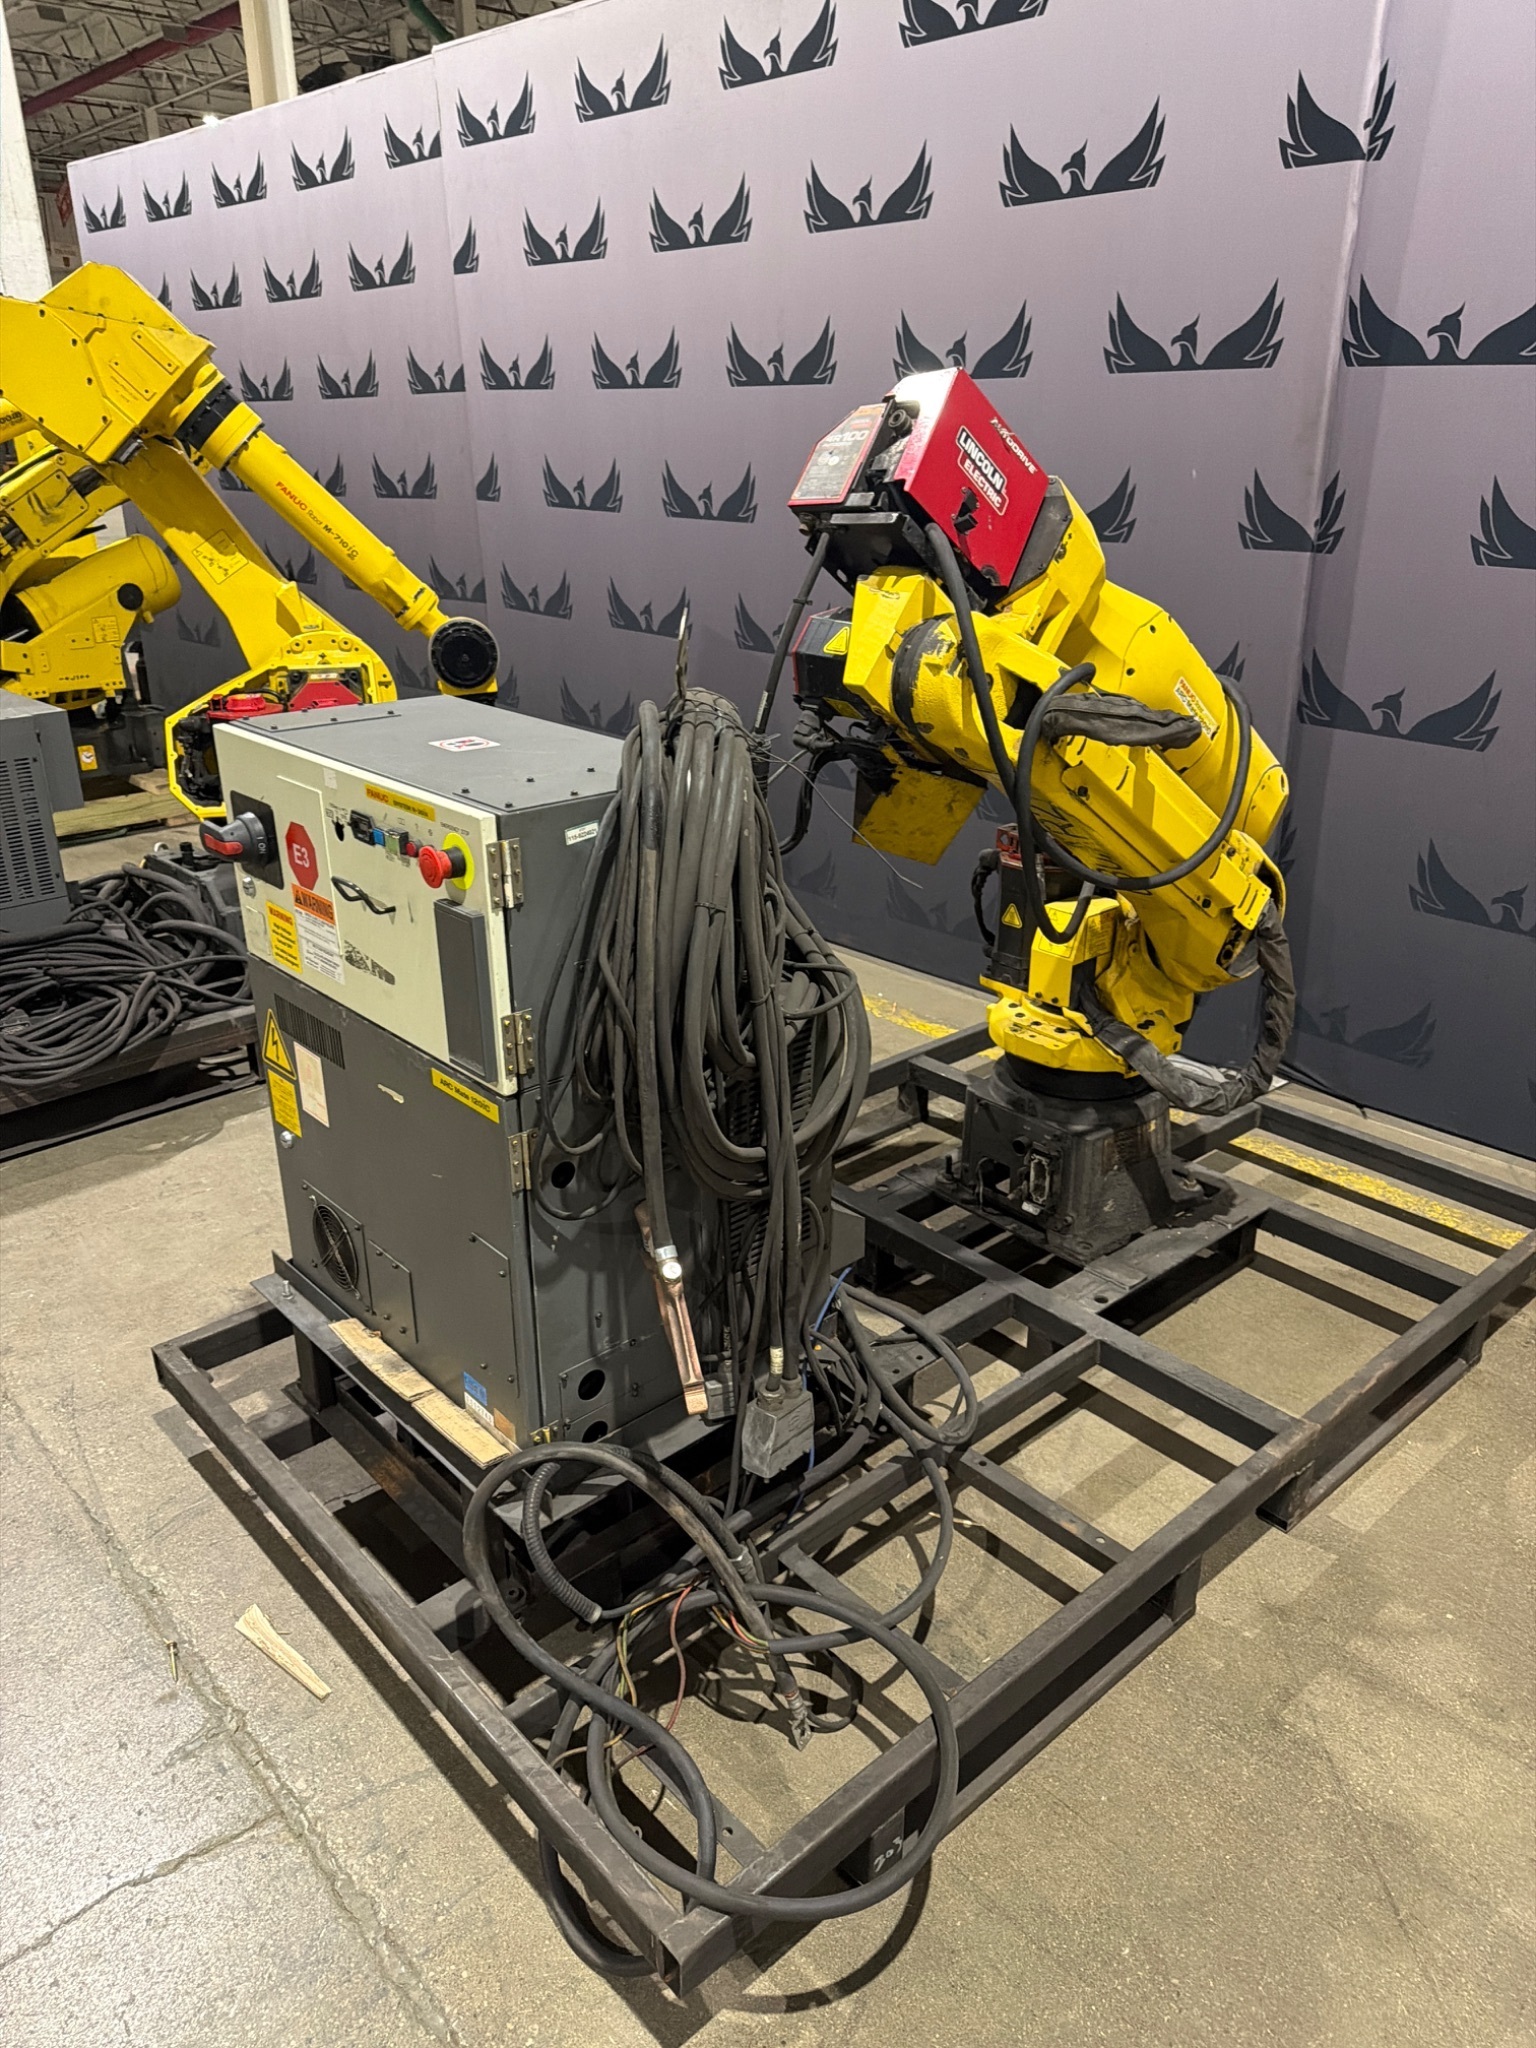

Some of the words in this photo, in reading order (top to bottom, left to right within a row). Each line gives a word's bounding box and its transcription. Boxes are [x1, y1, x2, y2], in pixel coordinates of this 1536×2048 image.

[959, 431, 1004, 491] LINCOLN
[275, 481, 308, 511] FANUC
[963, 458, 1003, 508] ELECTRIC
[366, 788, 389, 803] FANUC
[257, 842, 267, 854] ON
[292, 842, 310, 869] E3
[268, 905, 294, 927] WARNING
[300, 890, 335, 922] WARNING
[440, 1078, 454, 1091] ARC
[453, 1086, 470, 1101] Mate
